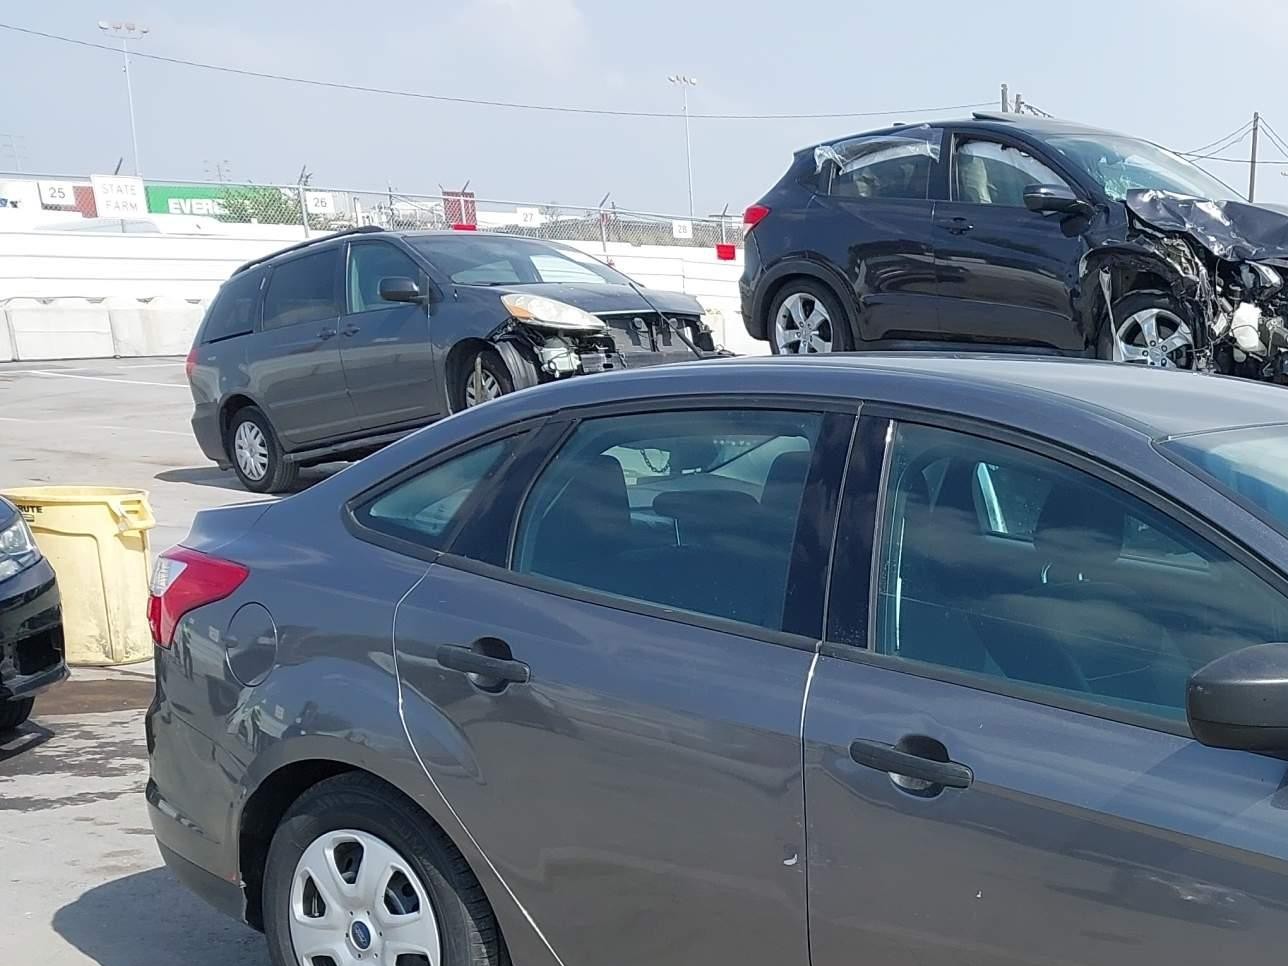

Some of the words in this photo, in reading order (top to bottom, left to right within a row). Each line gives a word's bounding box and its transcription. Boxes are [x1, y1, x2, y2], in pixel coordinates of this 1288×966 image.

[48, 187, 66, 199] 25
[102, 183, 136, 196] STATE
[105, 200, 138, 212] FARM
[313, 198, 327, 208] 26
